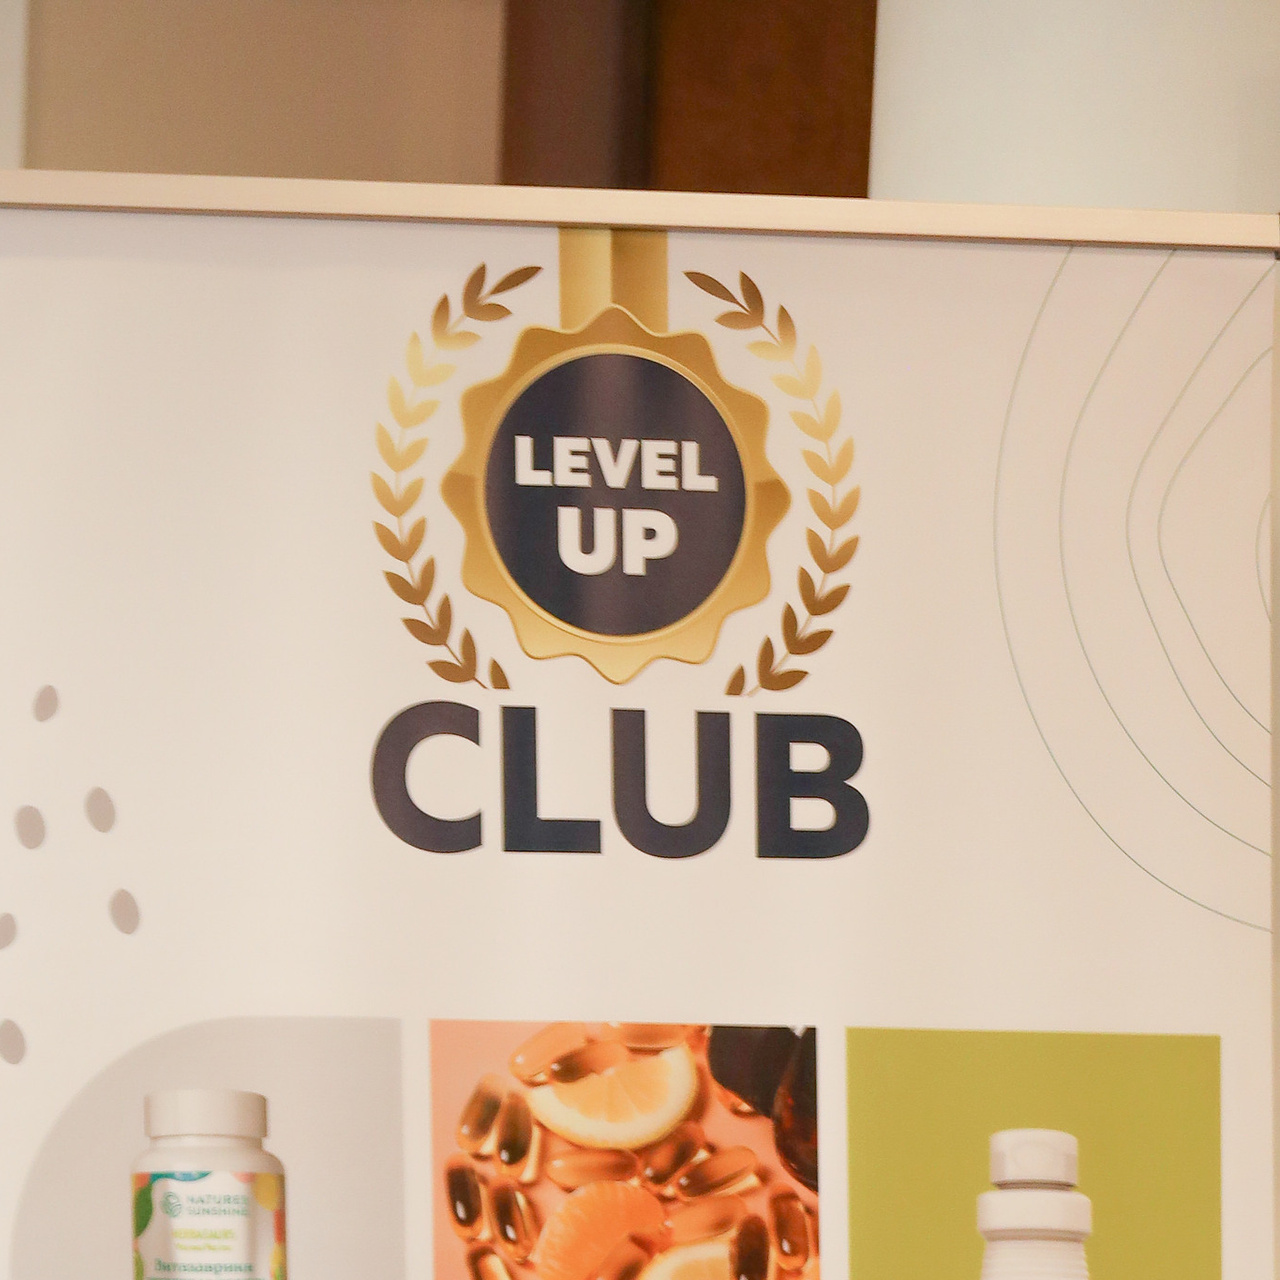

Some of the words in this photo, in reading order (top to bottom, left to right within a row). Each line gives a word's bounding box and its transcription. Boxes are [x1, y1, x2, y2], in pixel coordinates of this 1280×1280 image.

[514, 434, 719, 492] LEVEL
[556, 505, 679, 577] UP
[370, 698, 870, 860] CLUB
